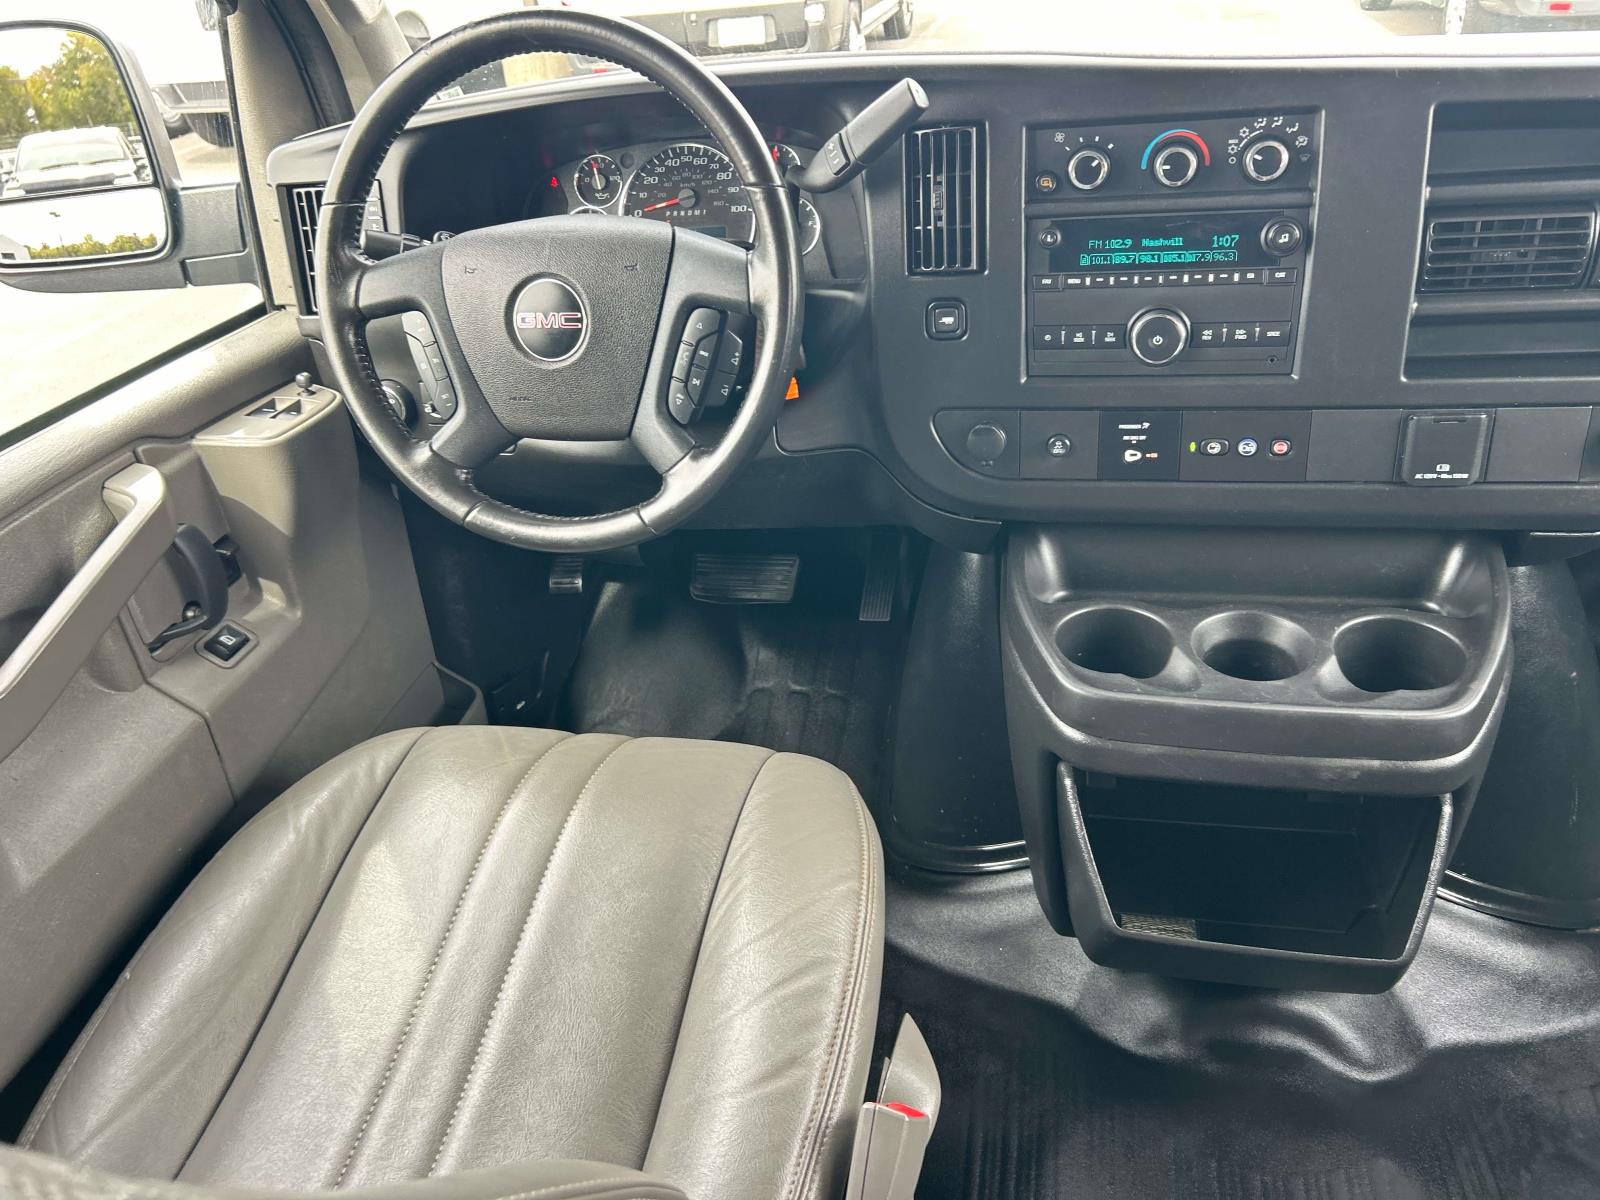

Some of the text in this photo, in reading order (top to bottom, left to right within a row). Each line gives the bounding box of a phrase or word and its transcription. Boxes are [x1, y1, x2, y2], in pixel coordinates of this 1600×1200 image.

[664, 158, 680, 167] 40
[680, 155, 693, 163] 50
[693, 157, 708, 165] 60
[716, 171, 732, 180] 80
[643, 176, 659, 185] 20
[634, 209, 643, 218] 0
[730, 205, 747, 213] 100
[1088, 240, 1102, 250] FM
[1104, 239, 1133, 249] 102.9
[1212, 234, 1240, 248] 1:07
[1213, 252, 1234, 261] 96.3
[516, 311, 582, 329] GMC
